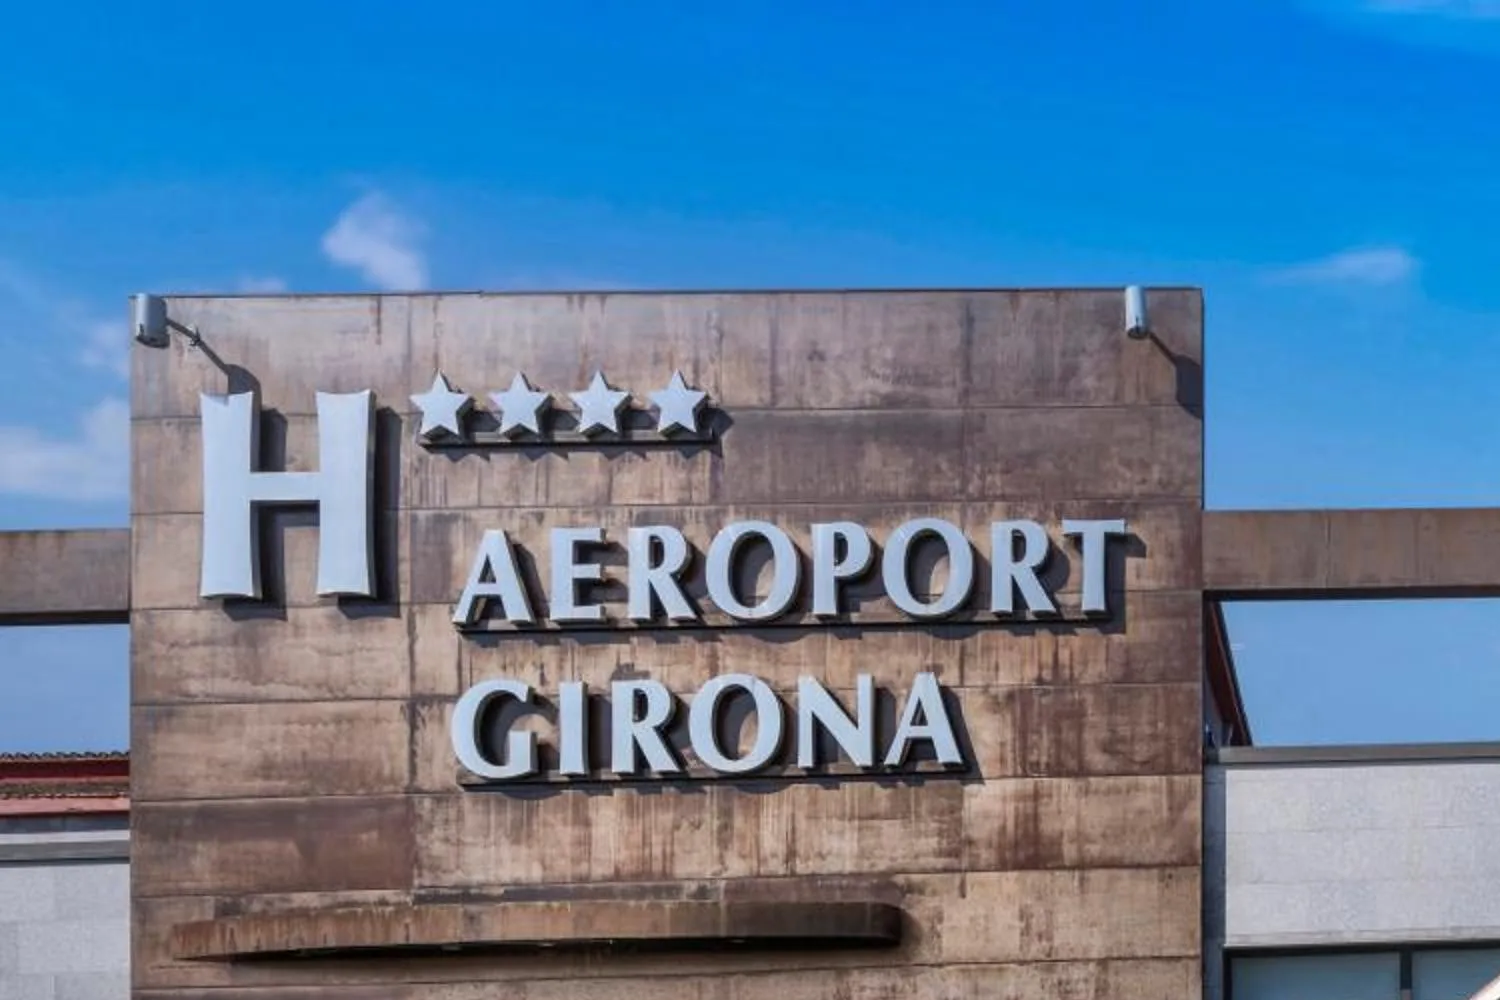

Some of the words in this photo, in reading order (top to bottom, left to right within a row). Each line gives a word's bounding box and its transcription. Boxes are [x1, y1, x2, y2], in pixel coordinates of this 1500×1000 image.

[200, 388, 376, 600] H
[452, 517, 1127, 626] AEROPORT
[450, 671, 964, 780] GIRONA
